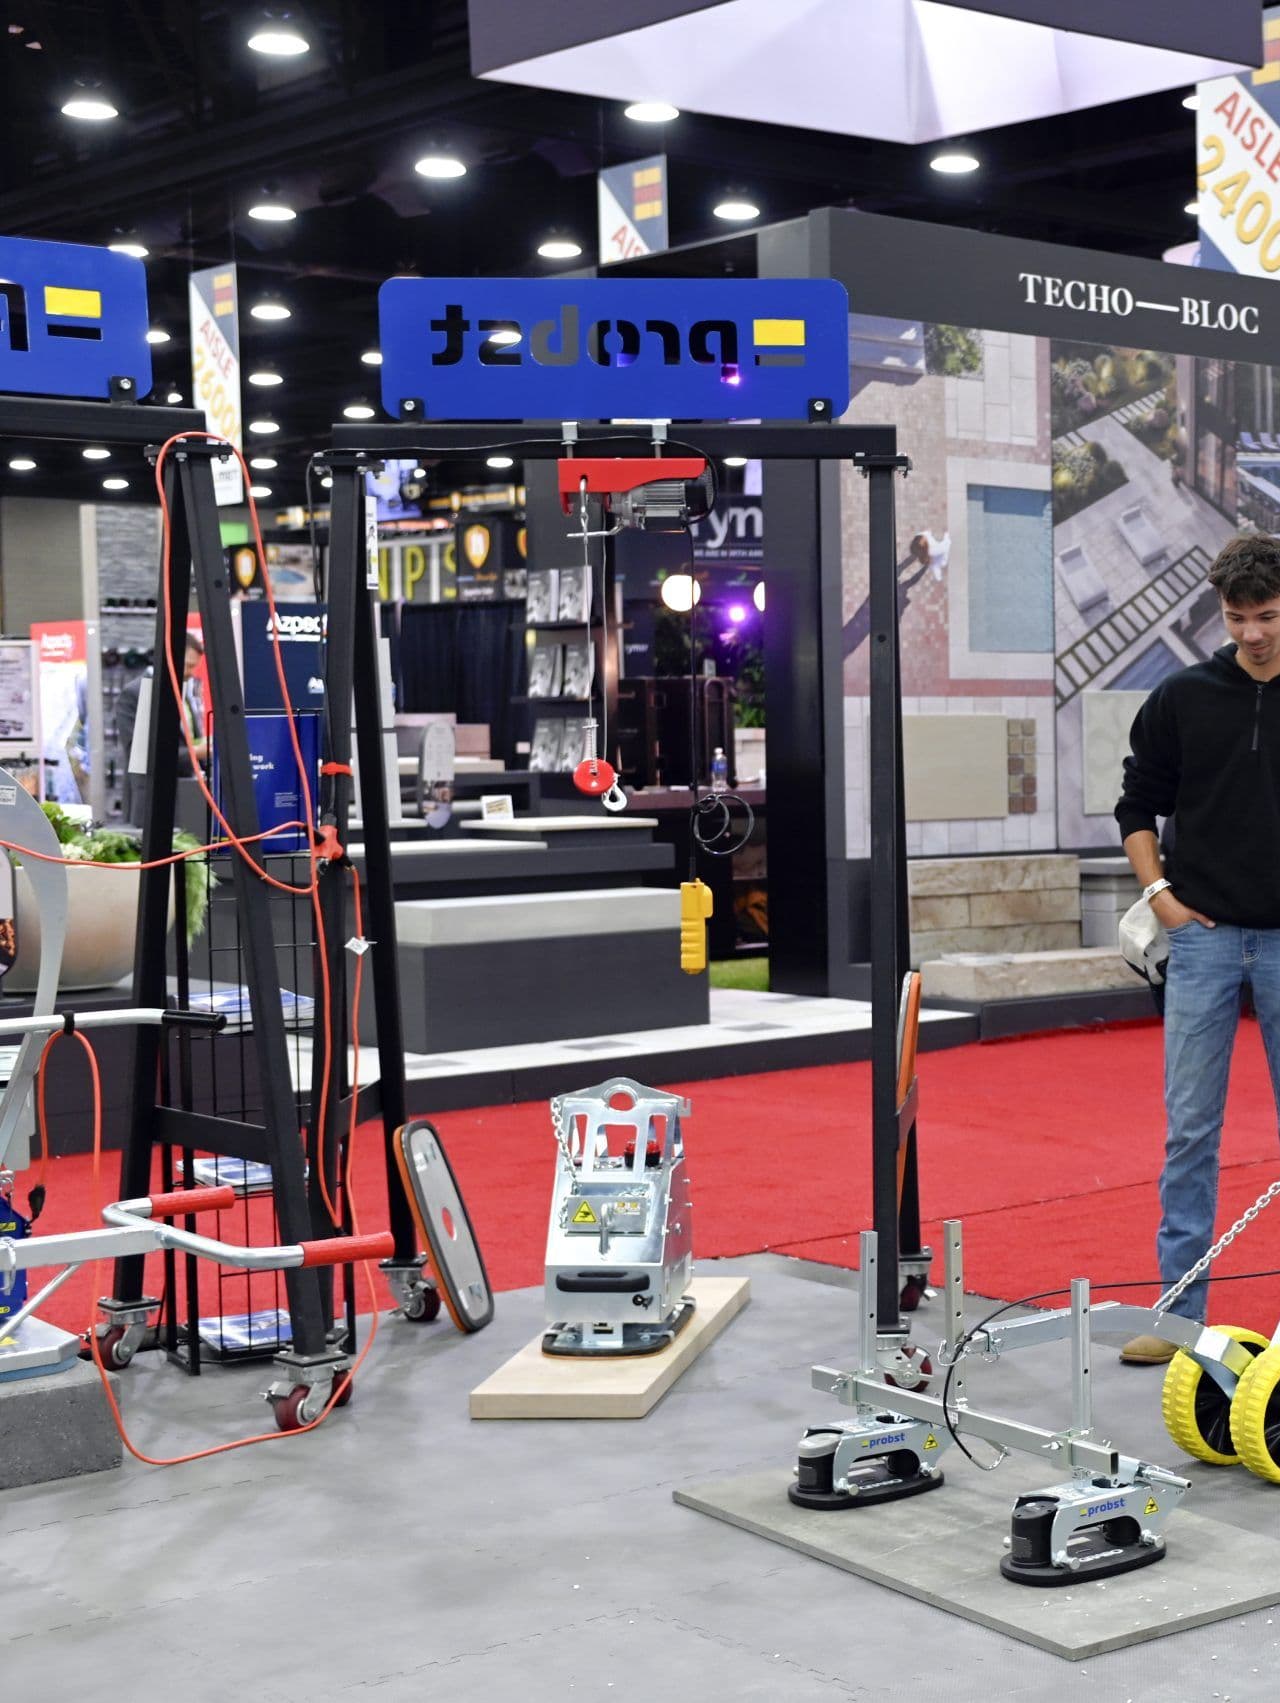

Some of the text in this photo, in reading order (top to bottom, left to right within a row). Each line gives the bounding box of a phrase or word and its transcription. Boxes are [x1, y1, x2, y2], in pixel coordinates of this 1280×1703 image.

[200, 318, 234, 379] AISLE
[869, 1432, 906, 1448] probst
[1088, 1497, 1126, 1517] probst
